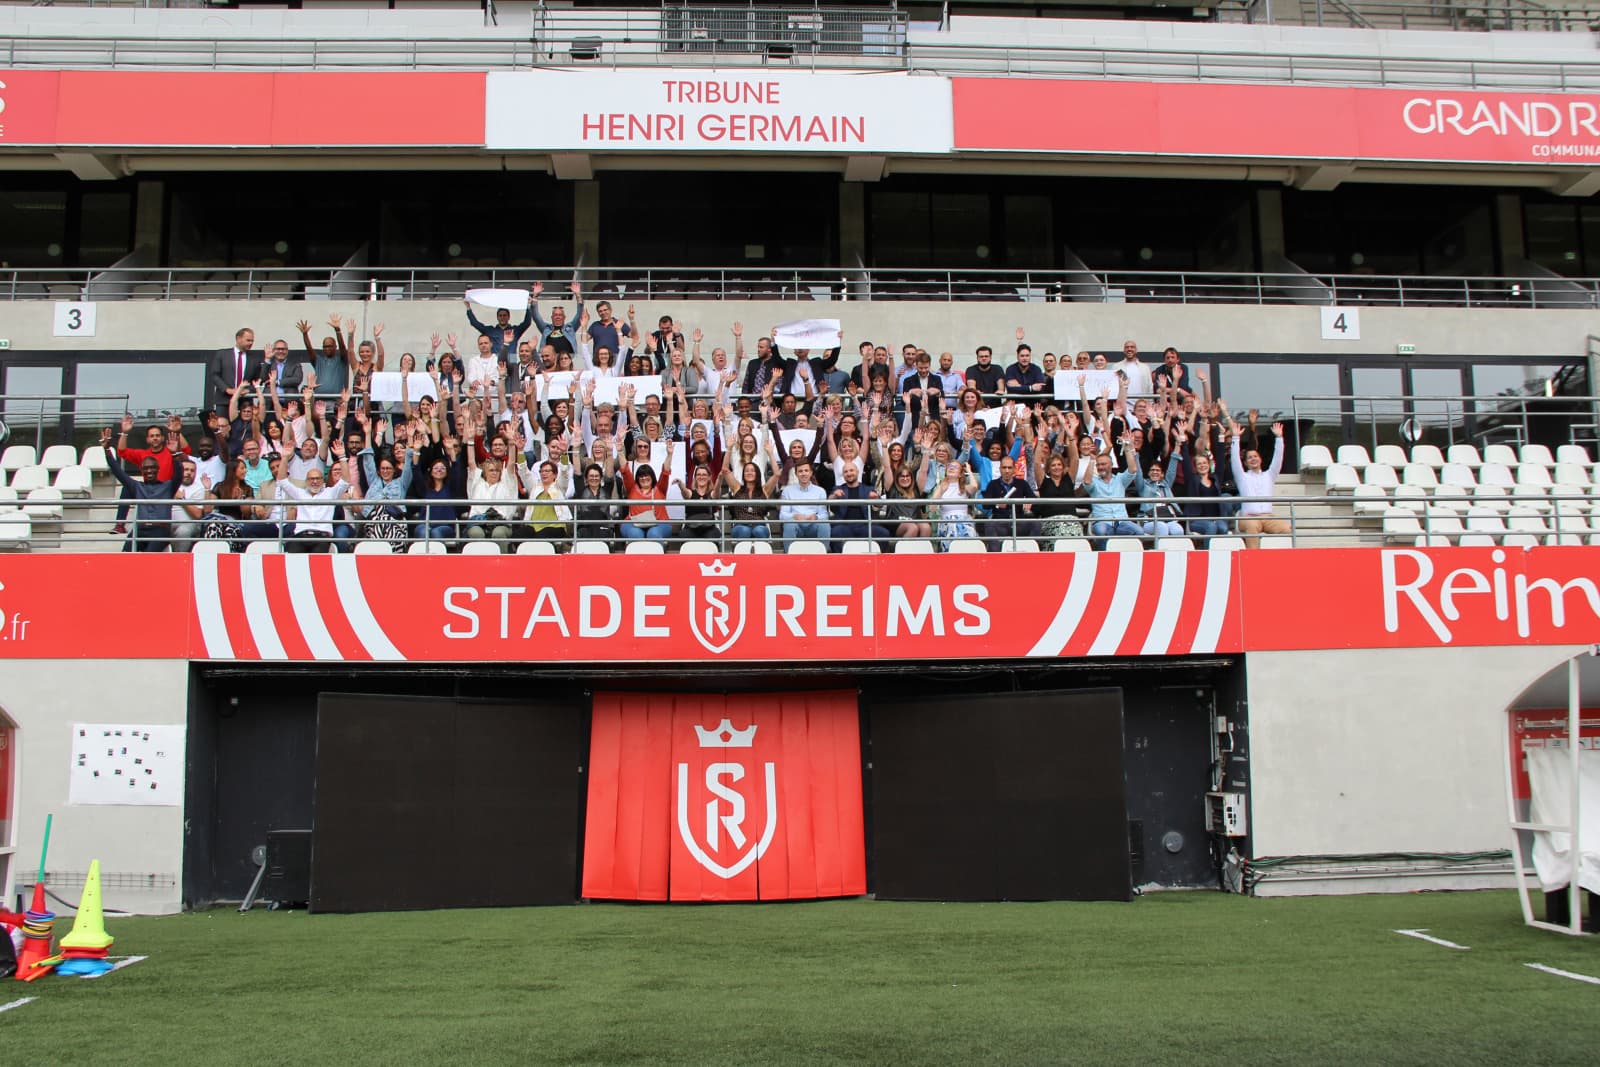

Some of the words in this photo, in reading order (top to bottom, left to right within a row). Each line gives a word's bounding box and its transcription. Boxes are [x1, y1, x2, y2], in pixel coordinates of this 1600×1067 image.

[663, 80, 780, 105] TRIBUNE
[582, 113, 685, 141] HENRI
[697, 113, 866, 143] GERMAIN
[1402, 97, 1563, 138] GRAND
[1568, 101, 1600, 138] R
[67, 308, 82, 330] 3
[1333, 313, 1348, 333] 4
[442, 585, 671, 639] STADE
[764, 584, 992, 637] REIMS
